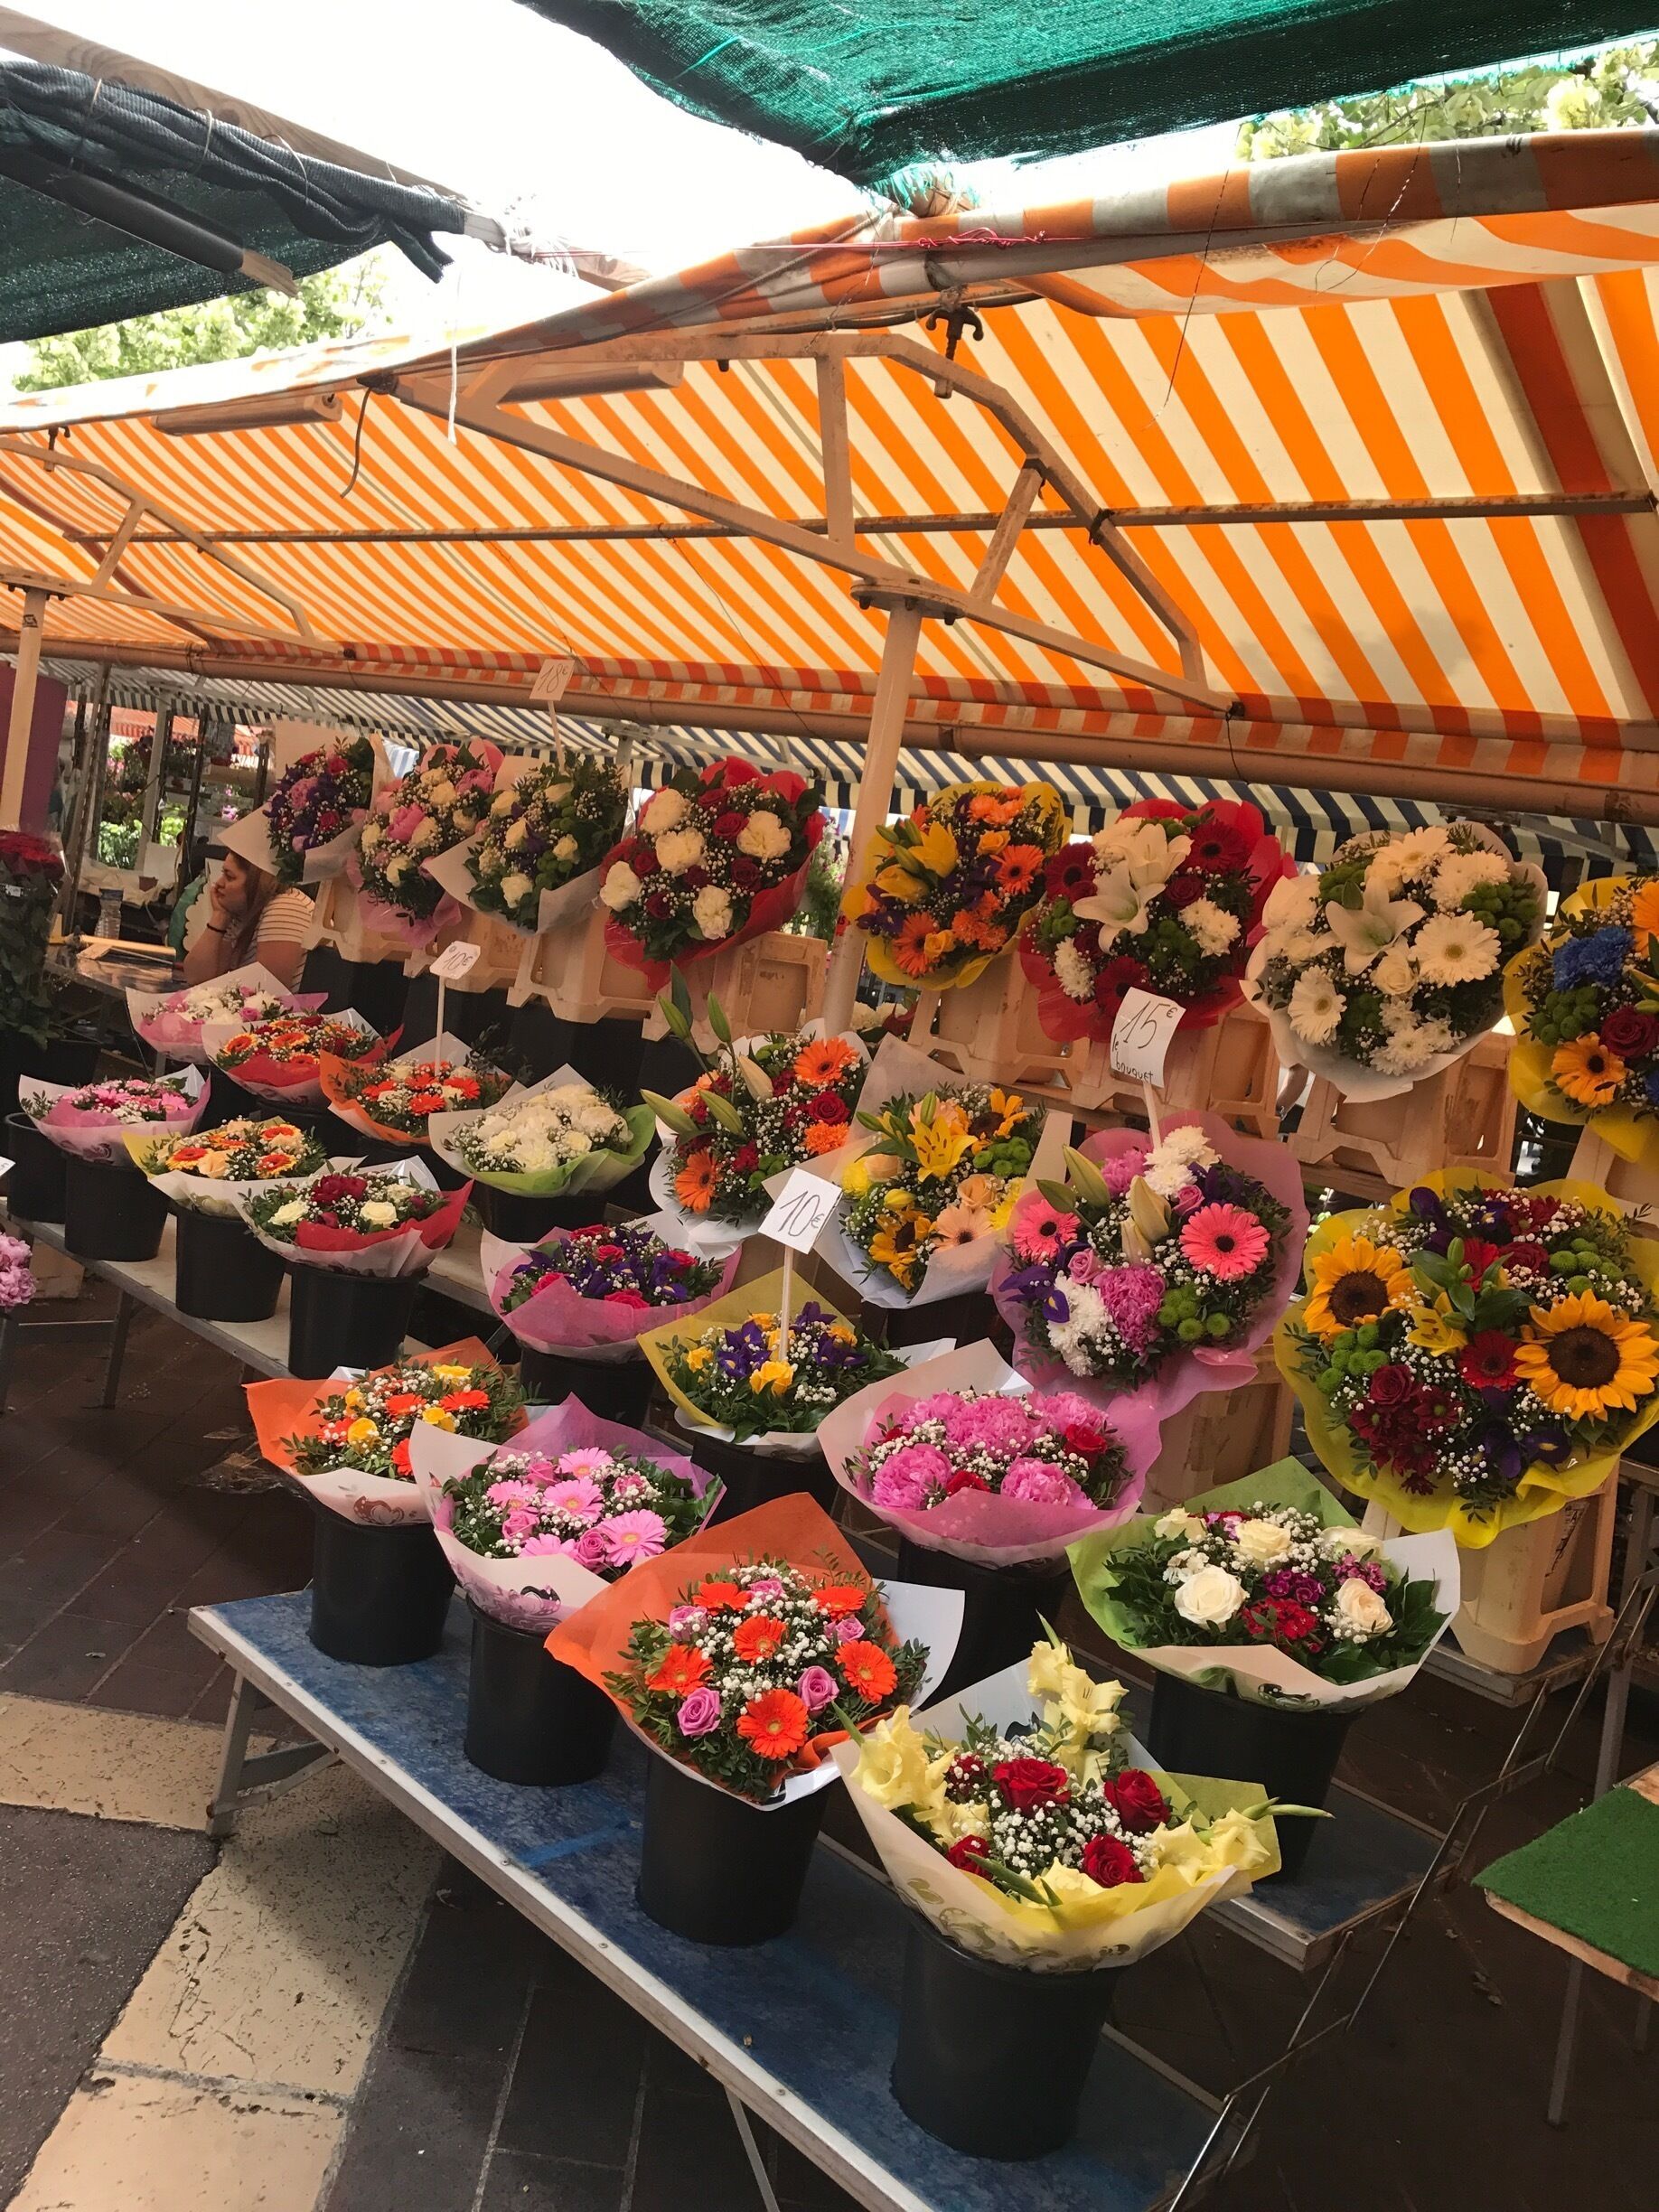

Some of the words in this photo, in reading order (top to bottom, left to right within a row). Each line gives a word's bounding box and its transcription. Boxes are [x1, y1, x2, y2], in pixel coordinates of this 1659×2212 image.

[1111, 1033, 1120, 1052] le
[1115, 1051, 1154, 1083] bouquet
[778, 1190, 825, 1237] 10€
